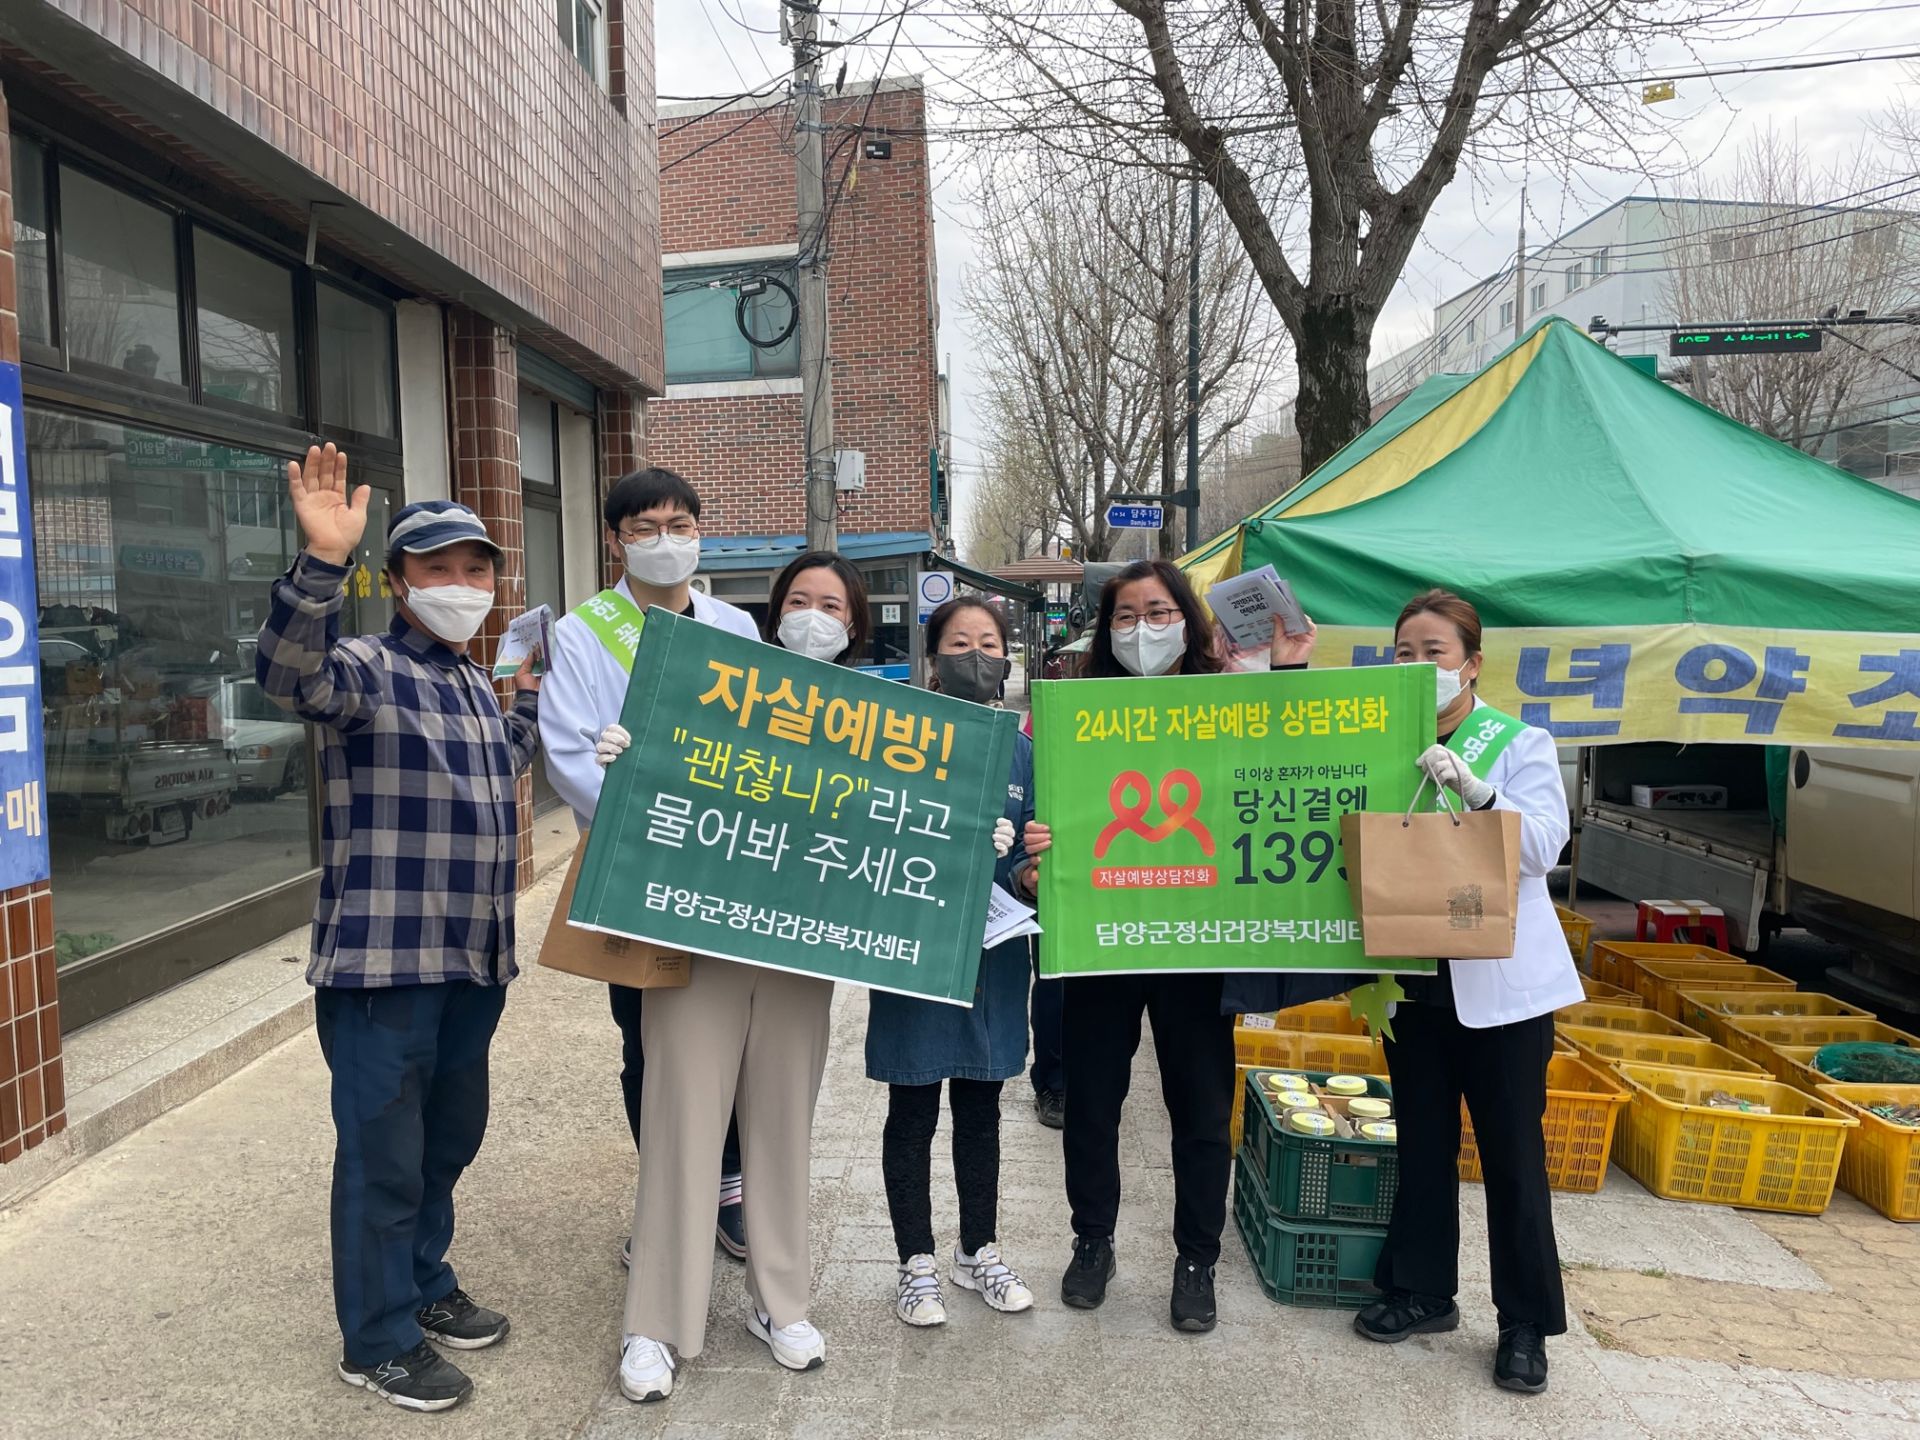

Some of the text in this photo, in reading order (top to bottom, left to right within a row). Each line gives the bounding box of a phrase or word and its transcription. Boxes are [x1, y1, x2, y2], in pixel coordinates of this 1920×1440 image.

[698, 659, 955, 781] 자살예방!
[1075, 695, 1389, 743] 24시간 자살예방 상담전화
[672, 727, 951, 840] "괜찮니?"라고
[1234, 763, 1368, 782] 더 이상 혼자가 아닙니다
[0, 780, 41, 845] 매
[646, 792, 946, 907] 물어봐 주세요.
[1099, 867, 1211, 887] 자살예방상담전화
[644, 882, 921, 965] 담양군정신건강복지센터
